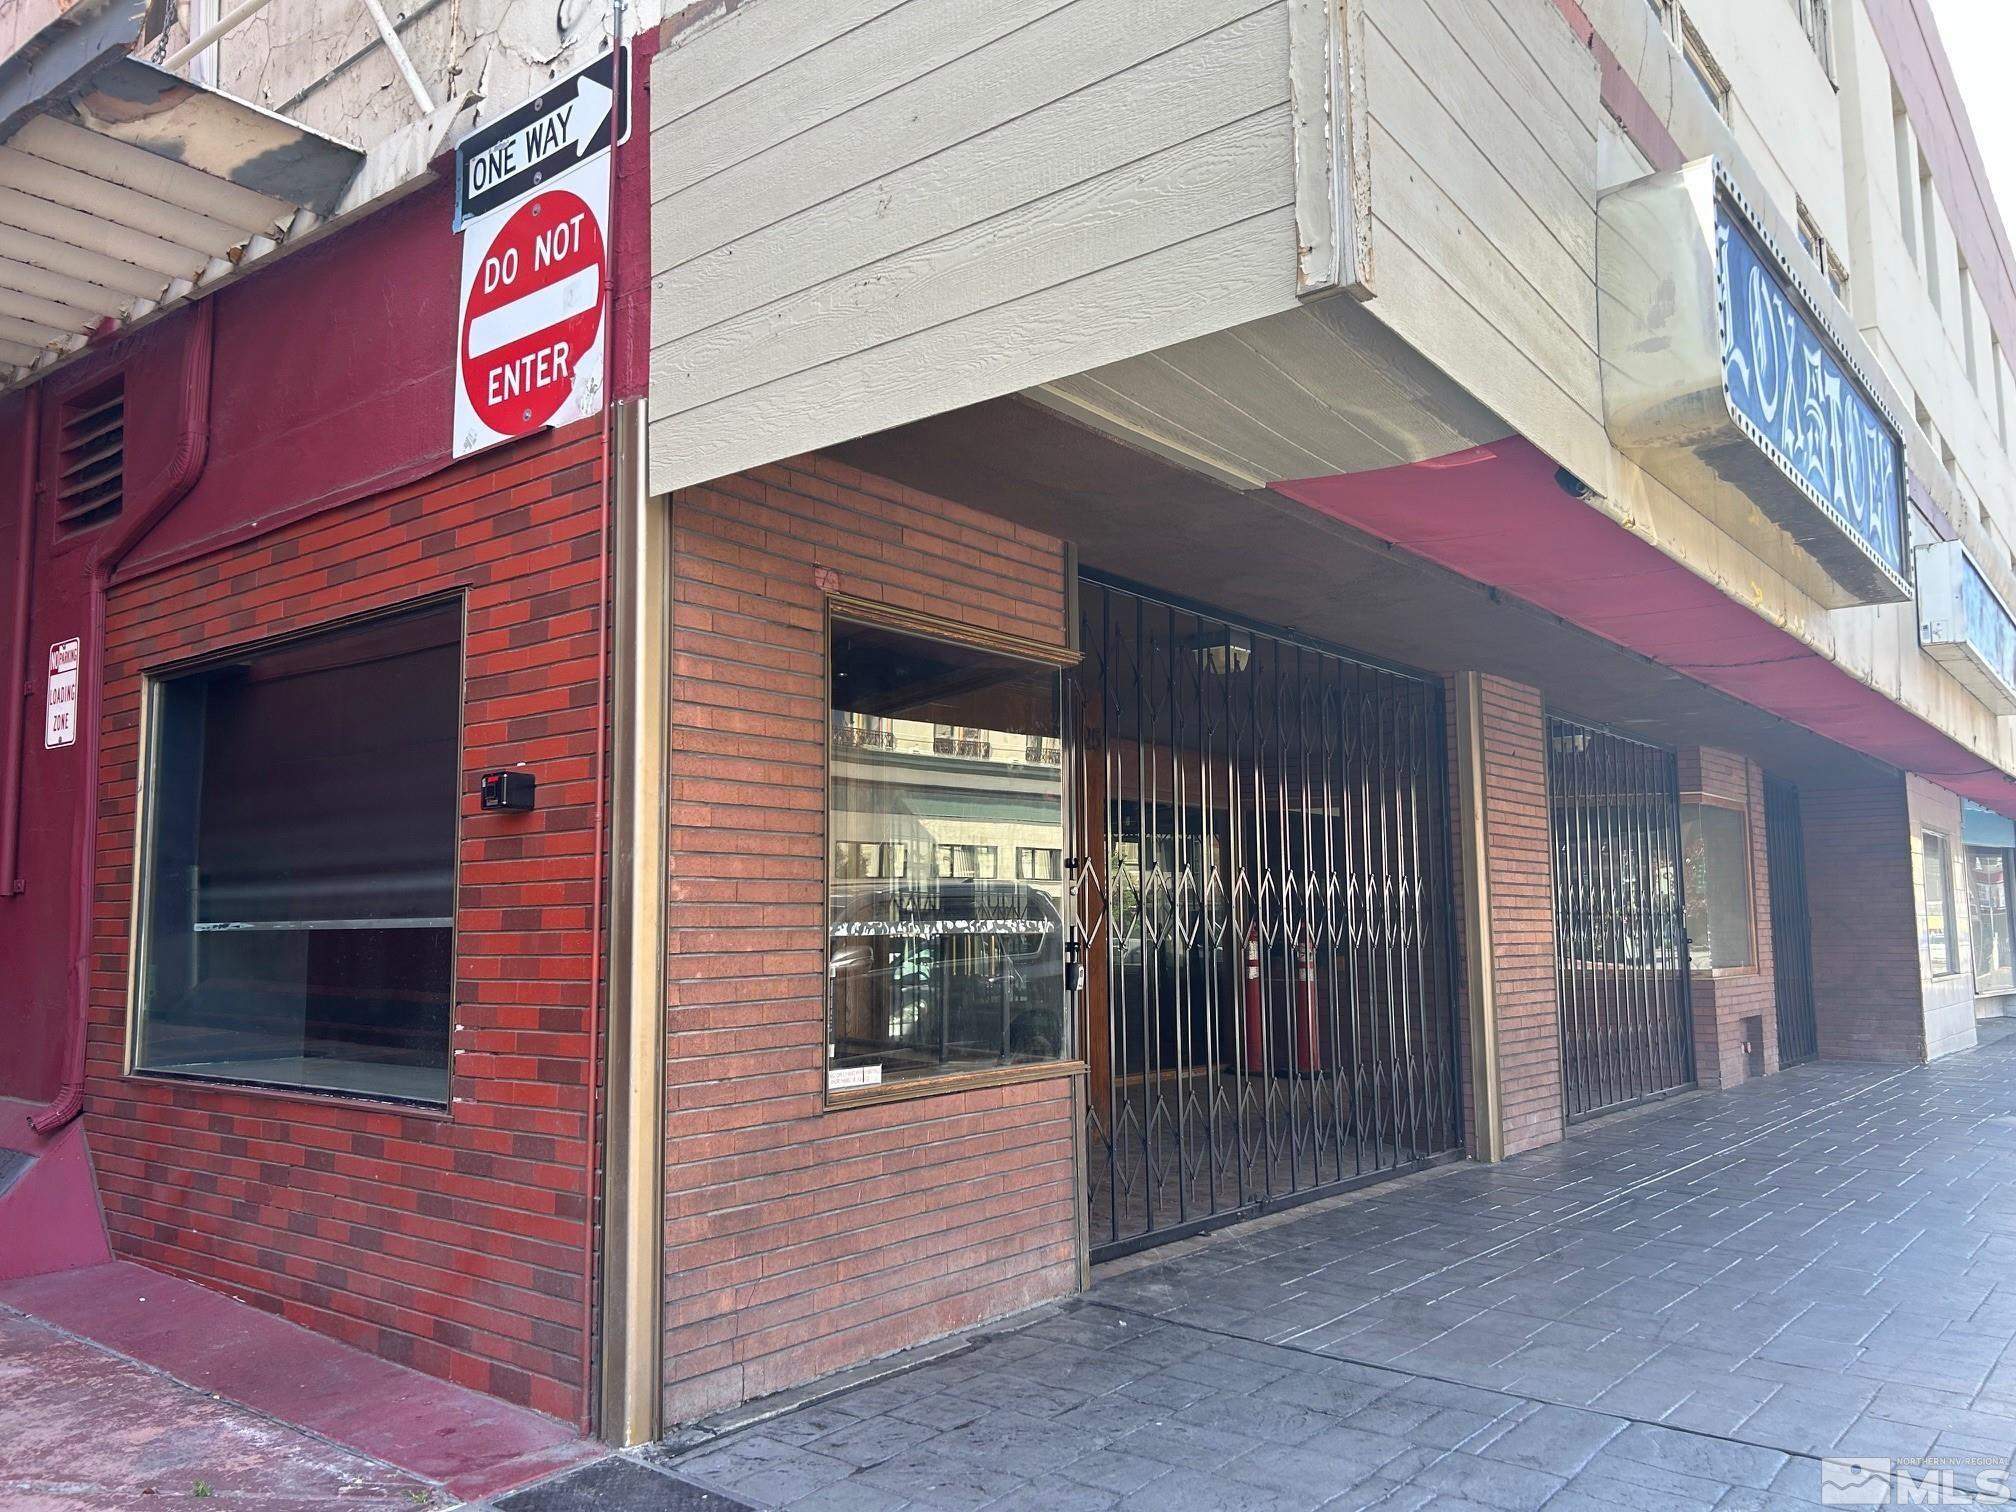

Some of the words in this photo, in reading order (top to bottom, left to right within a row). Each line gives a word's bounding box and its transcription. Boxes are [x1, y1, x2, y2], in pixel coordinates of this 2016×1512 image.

[473, 138, 517, 190] ONE
[526, 104, 573, 163] WAY
[484, 247, 519, 295] DO
[533, 213, 587, 272] NOT
[487, 341, 569, 407] ENTER
[51, 651, 59, 670] NO
[59, 649, 77, 662] PARKING
[50, 684, 75, 705] LOADING
[53, 713, 69, 731] ZONE
